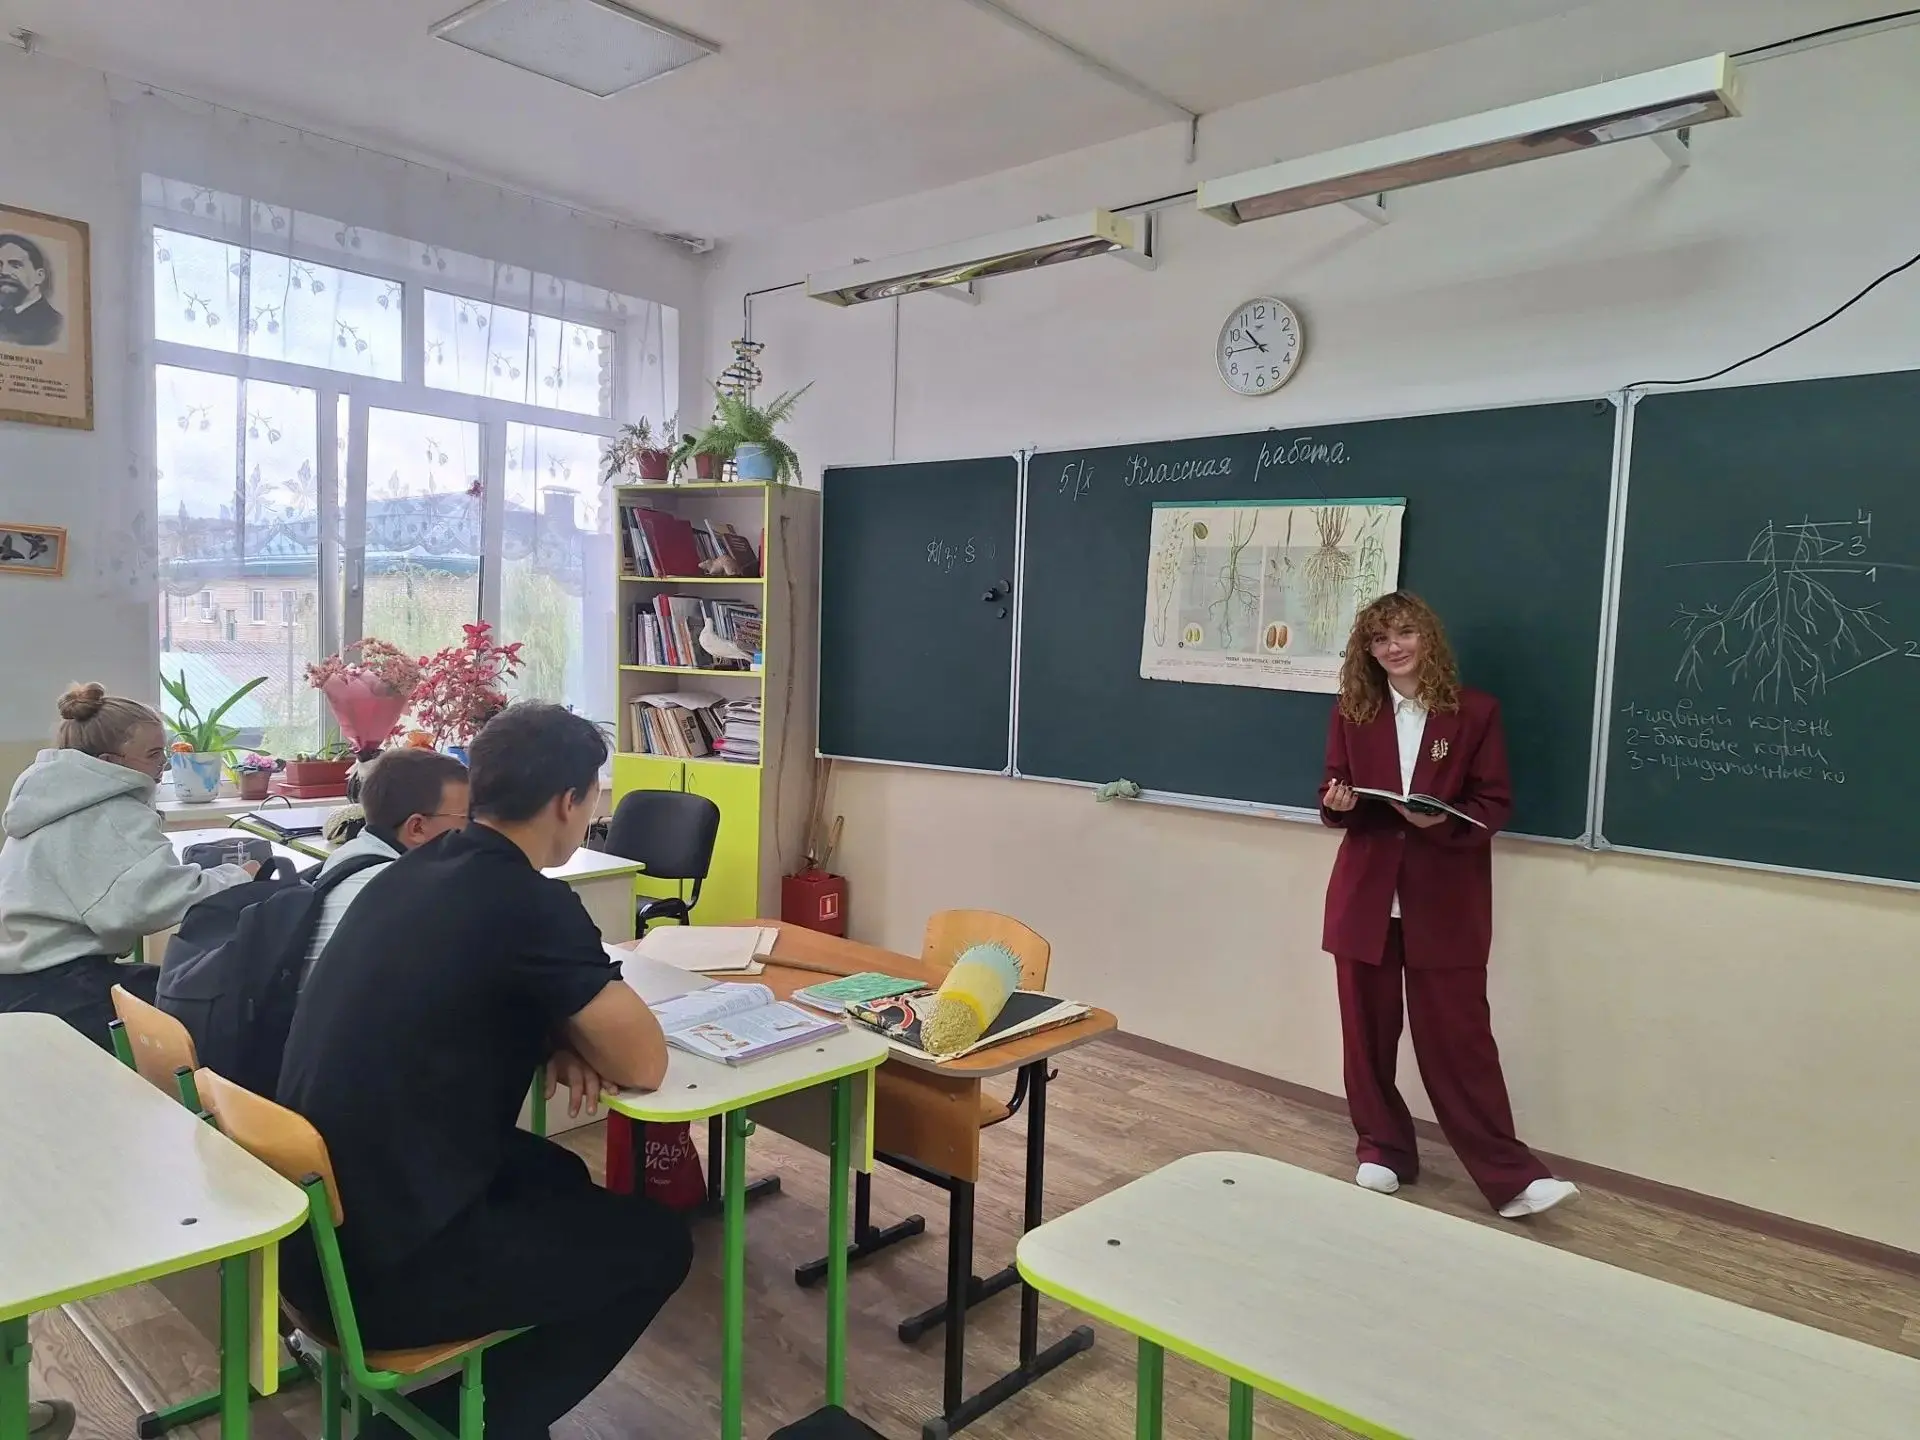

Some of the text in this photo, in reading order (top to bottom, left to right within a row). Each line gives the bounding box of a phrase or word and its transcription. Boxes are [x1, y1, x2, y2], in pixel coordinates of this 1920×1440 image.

[1253, 305, 1265, 319] 12
[1273, 306, 1277, 321] 1
[1240, 313, 1248, 328] 11
[1281, 317, 1291, 331] 2
[1229, 328, 1241, 342] 10
[1287, 333, 1296, 347] 3
[1225, 346, 1234, 360] 9
[1283, 351, 1291, 365] 4
[1230, 362, 1239, 376] 8
[1271, 366, 1280, 380] 5
[1242, 372, 1249, 385] 7
[1256, 374, 1265, 387] 6
[1124, 453, 1232, 487] Классная
[1253, 436, 1351, 483] работа.
[1857, 508, 1872, 538] 4
[1848, 535, 1867, 557] 3
[1864, 566, 1877, 583] 1
[1904, 640, 1920, 658] 2
[1750, 716, 1833, 751] корень
[1753, 744, 1829, 766] корни
[1822, 770, 1845, 784] ко
